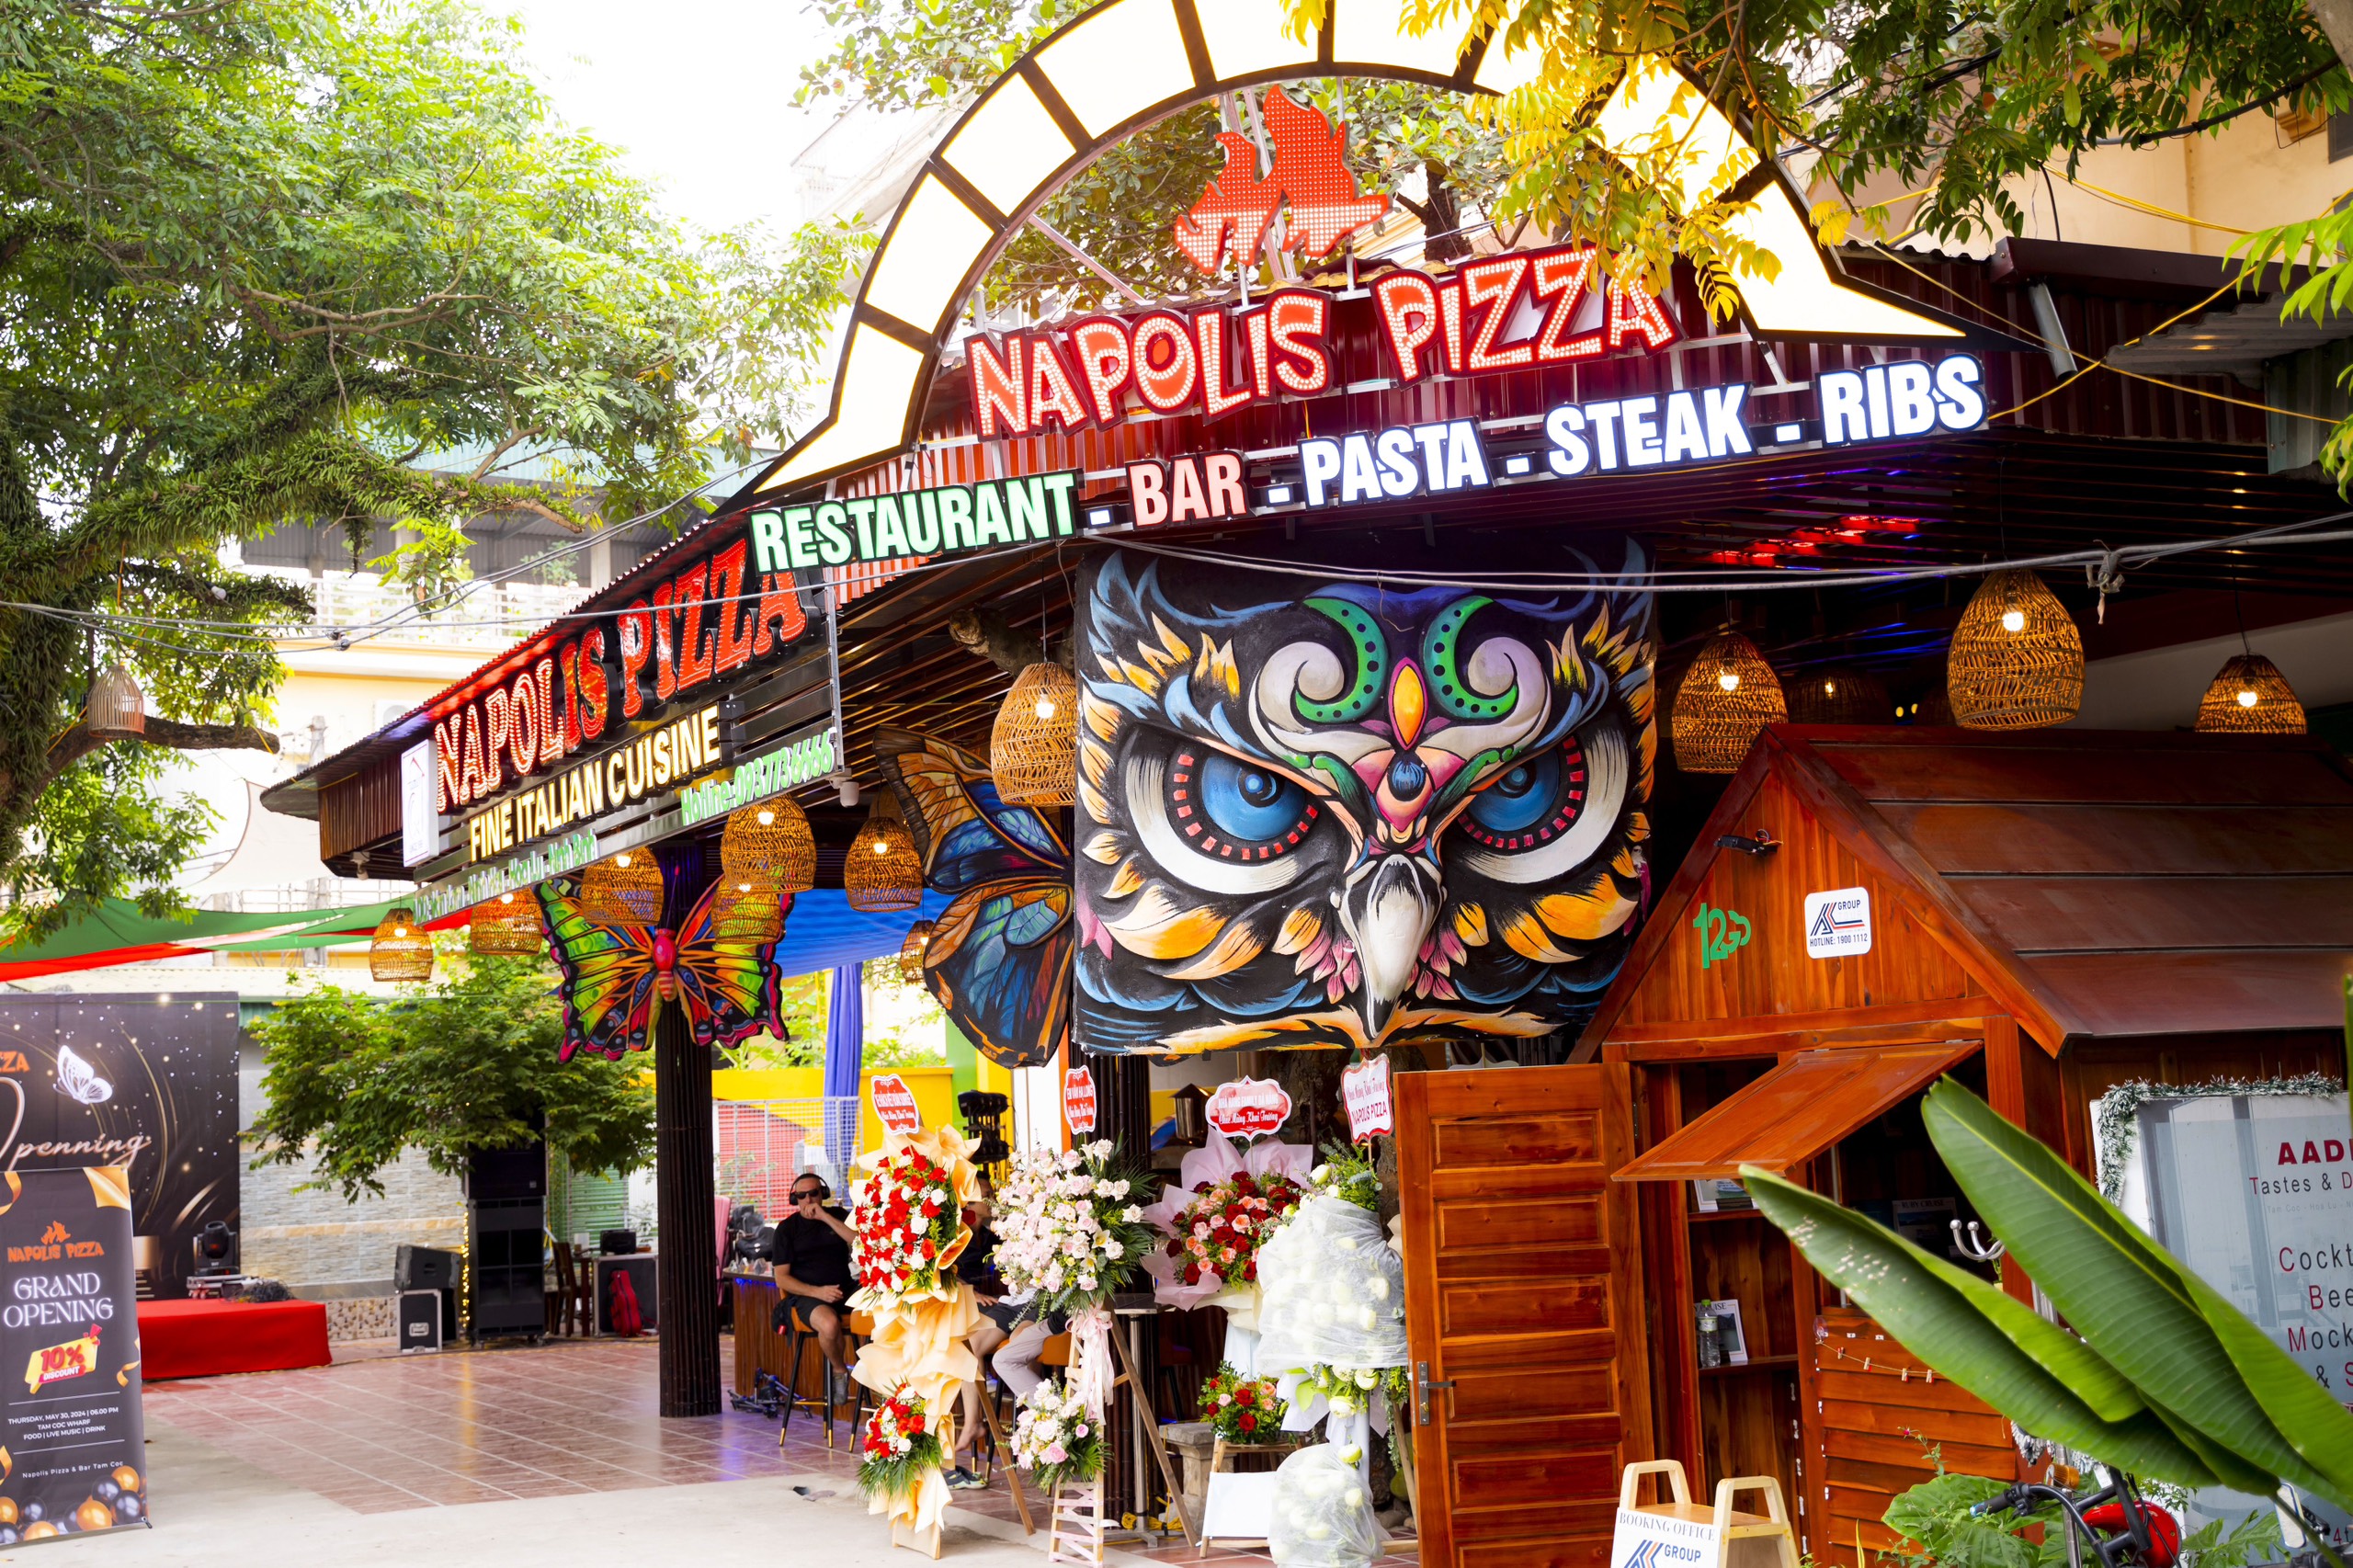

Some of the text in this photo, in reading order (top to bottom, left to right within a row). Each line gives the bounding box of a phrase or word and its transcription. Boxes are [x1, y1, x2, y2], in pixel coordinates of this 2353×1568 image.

[968, 247, 1675, 437] NAPOLIS PIZZA
[750, 472, 1077, 573] RESTAURANT
[1130, 453, 1247, 527] BAR
[1300, 421, 1488, 507] PASTA
[1547, 382, 1748, 476] STEAK
[1819, 356, 1984, 447] RIBS
[435, 538, 807, 813] NAPOLIS PIZZA
[470, 706, 720, 862] FINE ITALIAN CUISINE
[1837, 900, 1861, 910] GROUP
[1810, 933, 1869, 948] HOTLINE: 1900 1112
[2278, 1139, 2353, 1165] AAD
[2249, 1176, 2312, 1195] Tastes
[2322, 1173, 2332, 1191] &
[7, 1241, 105, 1263] NAPOLIS PIZZA
[14, 1272, 101, 1300] GRAND
[3, 1297, 114, 1328] OPENING
[40, 1344, 85, 1371] 10%
[43, 1366, 80, 1381] DISCOUNT
[8, 1415, 44, 1425] THURSDAY,
[45, 1413, 60, 1421] MAY
[61, 1412, 70, 1420] 30,
[71, 1410, 86, 1418] 2024
[67, 1419, 91, 1427] WHARF
[46, 1430, 60, 1438] LIVE
[61, 1428, 82, 1437] MUSIC
[85, 1426, 106, 1434] DRINK
[22, 1470, 49, 1479] Napolis
[1620, 1512, 1715, 1541] BOOKING OFFICE
[1665, 1544, 1701, 1562] GROUP
